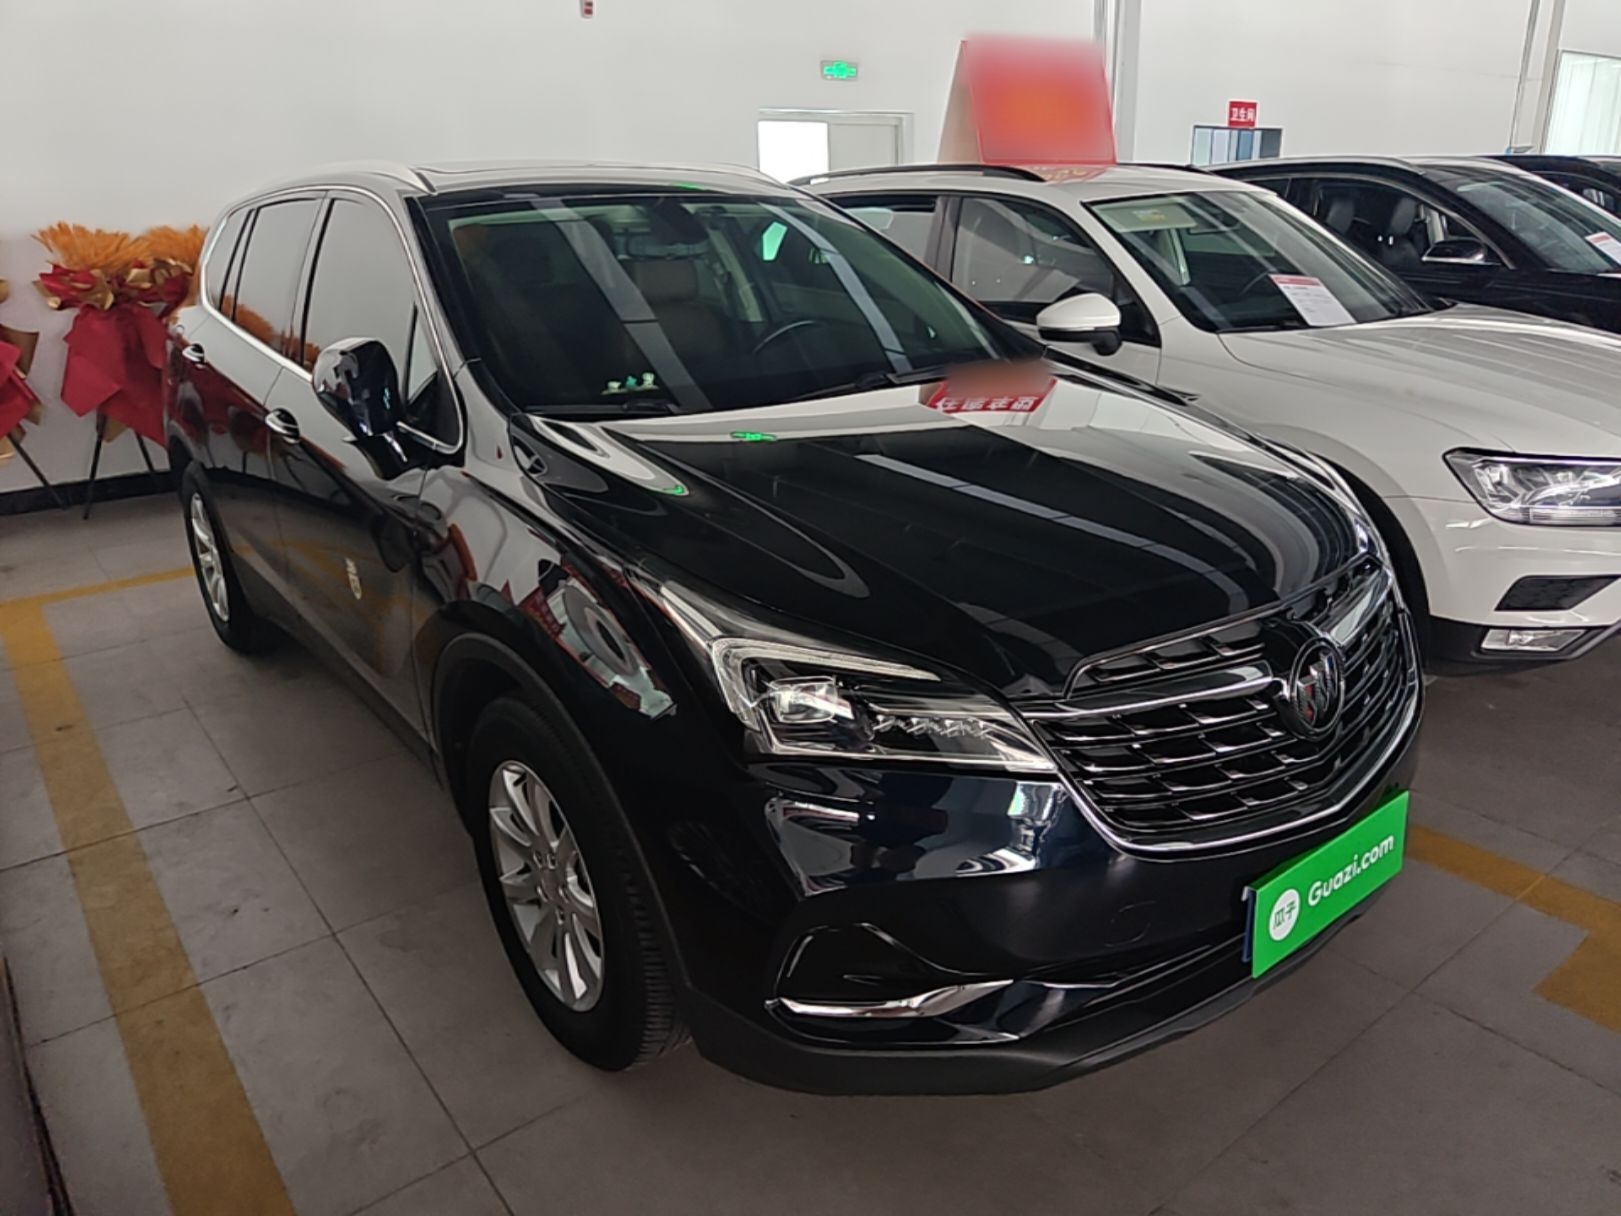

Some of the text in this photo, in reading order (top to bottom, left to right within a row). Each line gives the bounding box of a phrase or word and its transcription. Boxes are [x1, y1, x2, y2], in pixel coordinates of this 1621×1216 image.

[1230, 107, 1255, 121] 卫生间
[1308, 835, 1394, 906] Guazi.com
